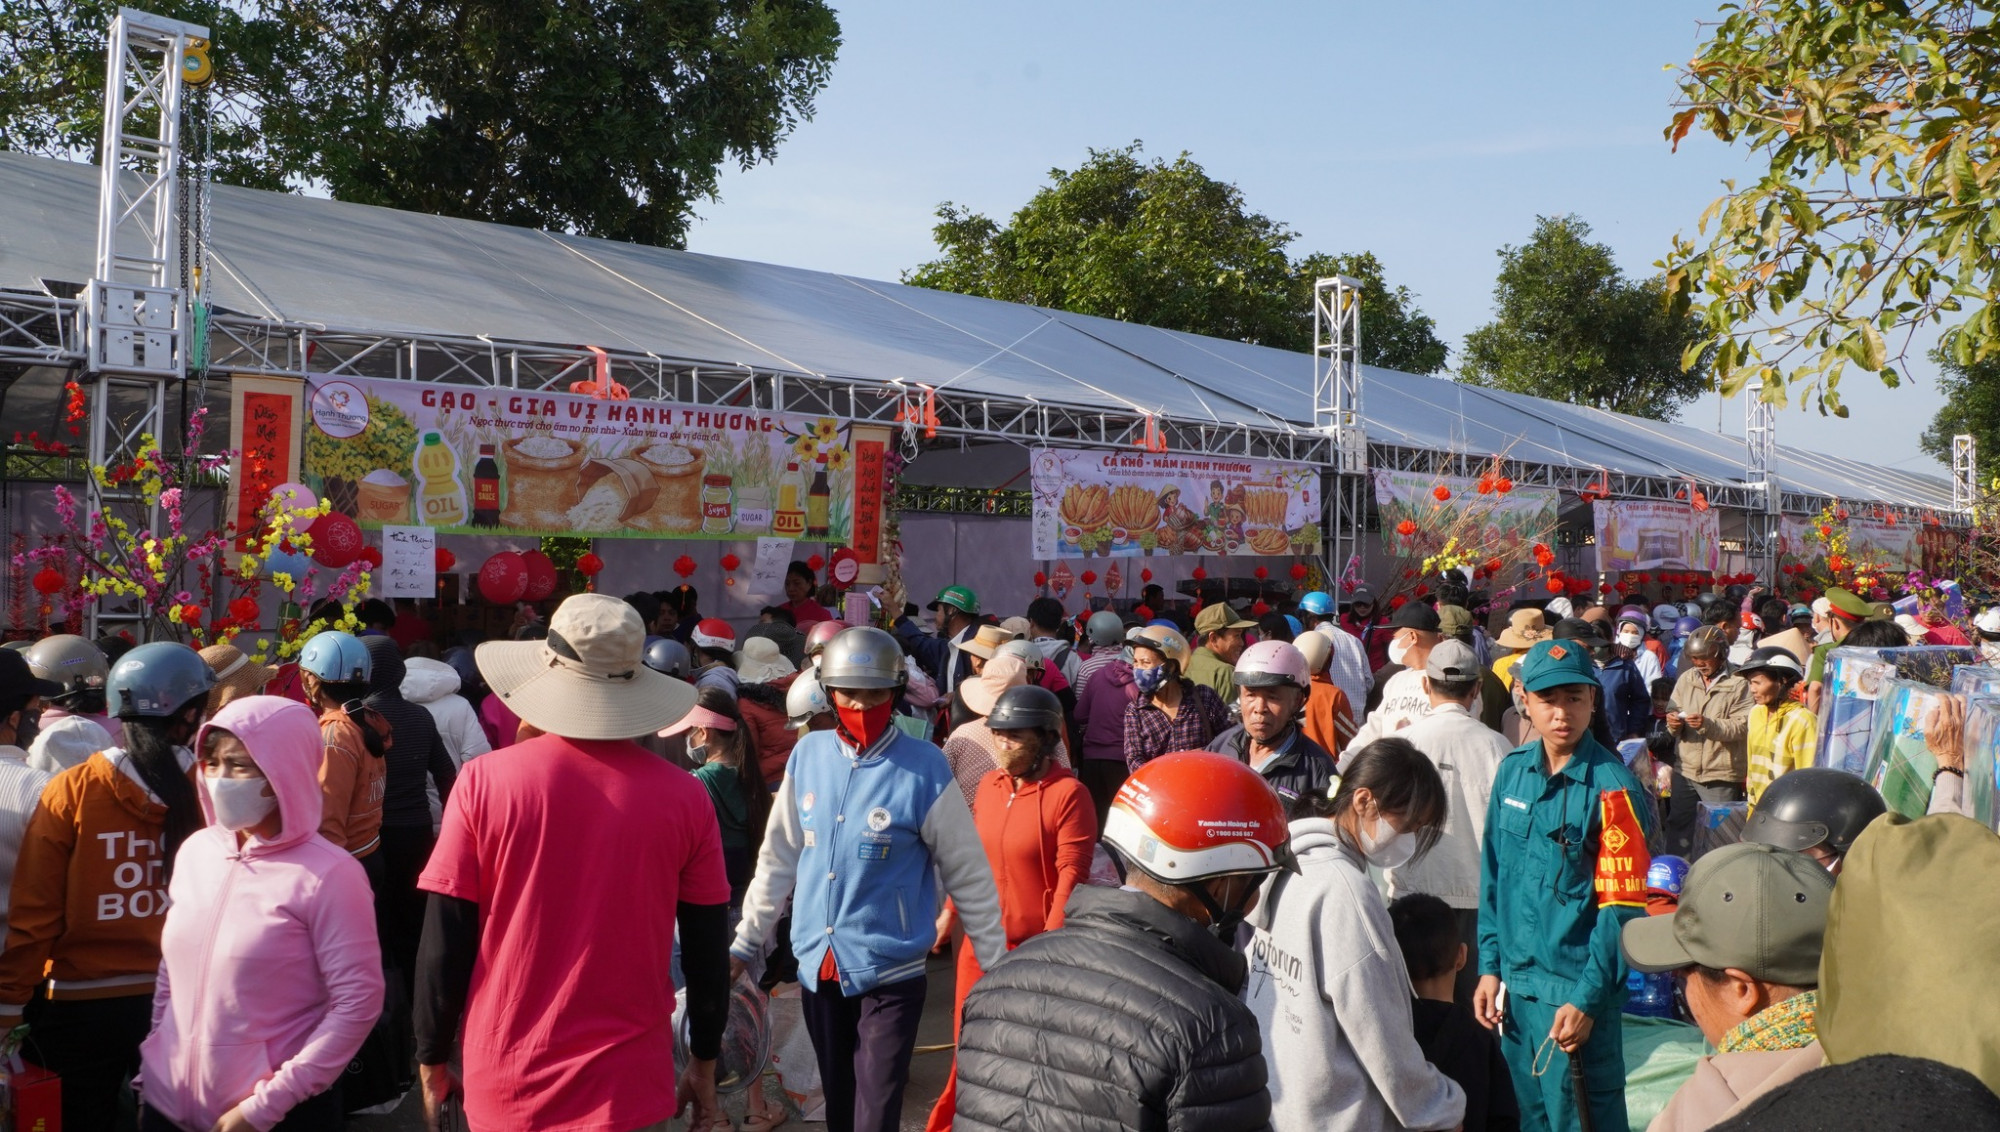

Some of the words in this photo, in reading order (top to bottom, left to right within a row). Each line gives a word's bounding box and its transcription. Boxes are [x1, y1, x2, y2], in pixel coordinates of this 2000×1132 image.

[422, 390, 475, 414] GẠO
[509, 397, 556, 416] GIA
[569, 402, 598, 424] VỊ
[608, 405, 672, 427] HẠNH
[683, 410, 772, 432] THƯƠNG
[468, 416, 493, 427] Ngọc
[536, 420, 552, 431] cho
[569, 424, 581, 433] no
[582, 424, 599, 435] mọi
[645, 429, 658, 438] vui
[669, 430, 682, 440] gia
[1120, 452, 1144, 468] KHÔ
[478, 492, 496, 501] SAUCE
[370, 501, 401, 510] SUGAR
[426, 497, 460, 515] OIL
[741, 513, 764, 522] SUGAR
[776, 516, 801, 528] OIL
[1227, 820, 1248, 829] Hoàng
[1600, 857, 1633, 873] DQTV
[1625, 875, 1640, 892] BẢO
[97, 889, 174, 920] BOX
